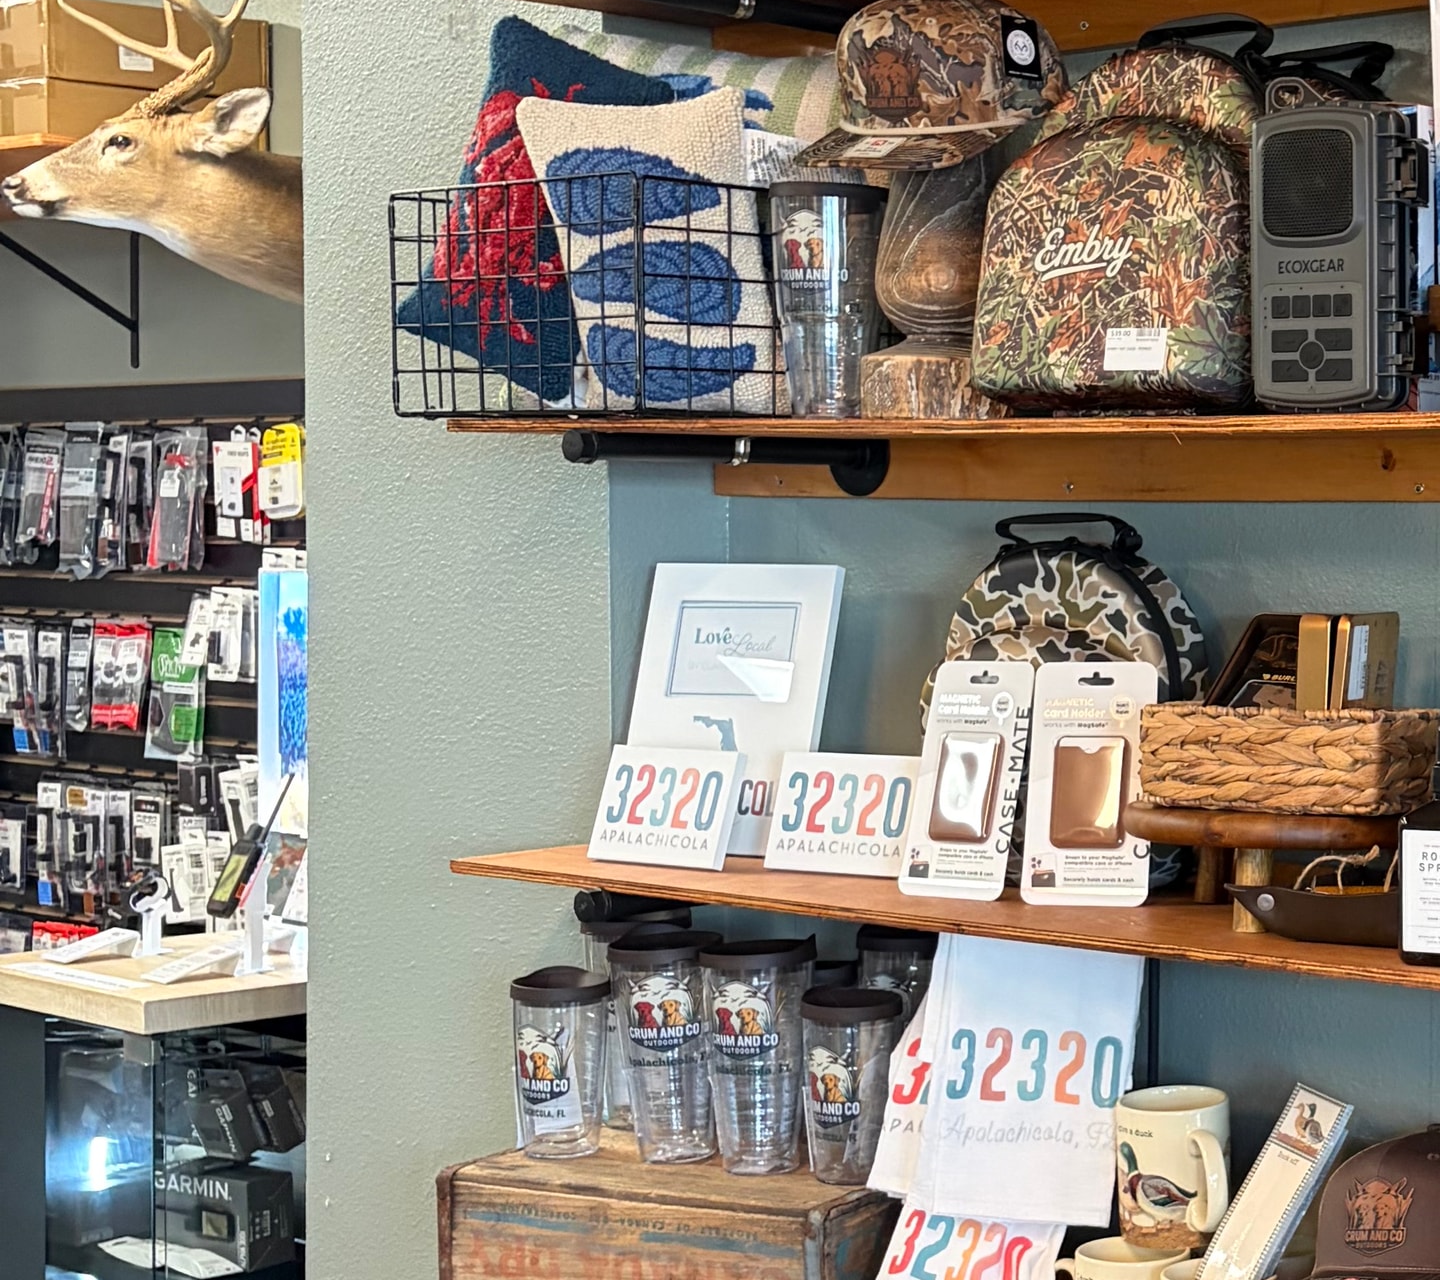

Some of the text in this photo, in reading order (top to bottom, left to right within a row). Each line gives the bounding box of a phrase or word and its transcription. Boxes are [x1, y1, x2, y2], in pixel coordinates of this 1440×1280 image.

[1034, 225, 1135, 278] Embry
[1277, 258, 1345, 275] ECOXGEAR
[694, 627, 733, 646] Love
[606, 764, 724, 832] 32320
[781, 771, 912, 838] 32320
[600, 830, 709, 851] APALACHICOLA
[776, 839, 901, 859] APALACHICOLA
[629, 1023, 700, 1040] CRUM AND CO
[737, 1034, 760, 1047] AND
[762, 1033, 779, 1046] CO
[643, 1038, 684, 1047] OUTDOORS
[946, 1027, 1124, 1109] 32320
[530, 1079, 568, 1093] AND CO
[823, 1102, 860, 1116] AND CO
[1135, 1128, 1154, 1138] duck
[1345, 1229, 1403, 1242] CRUM AND CO
